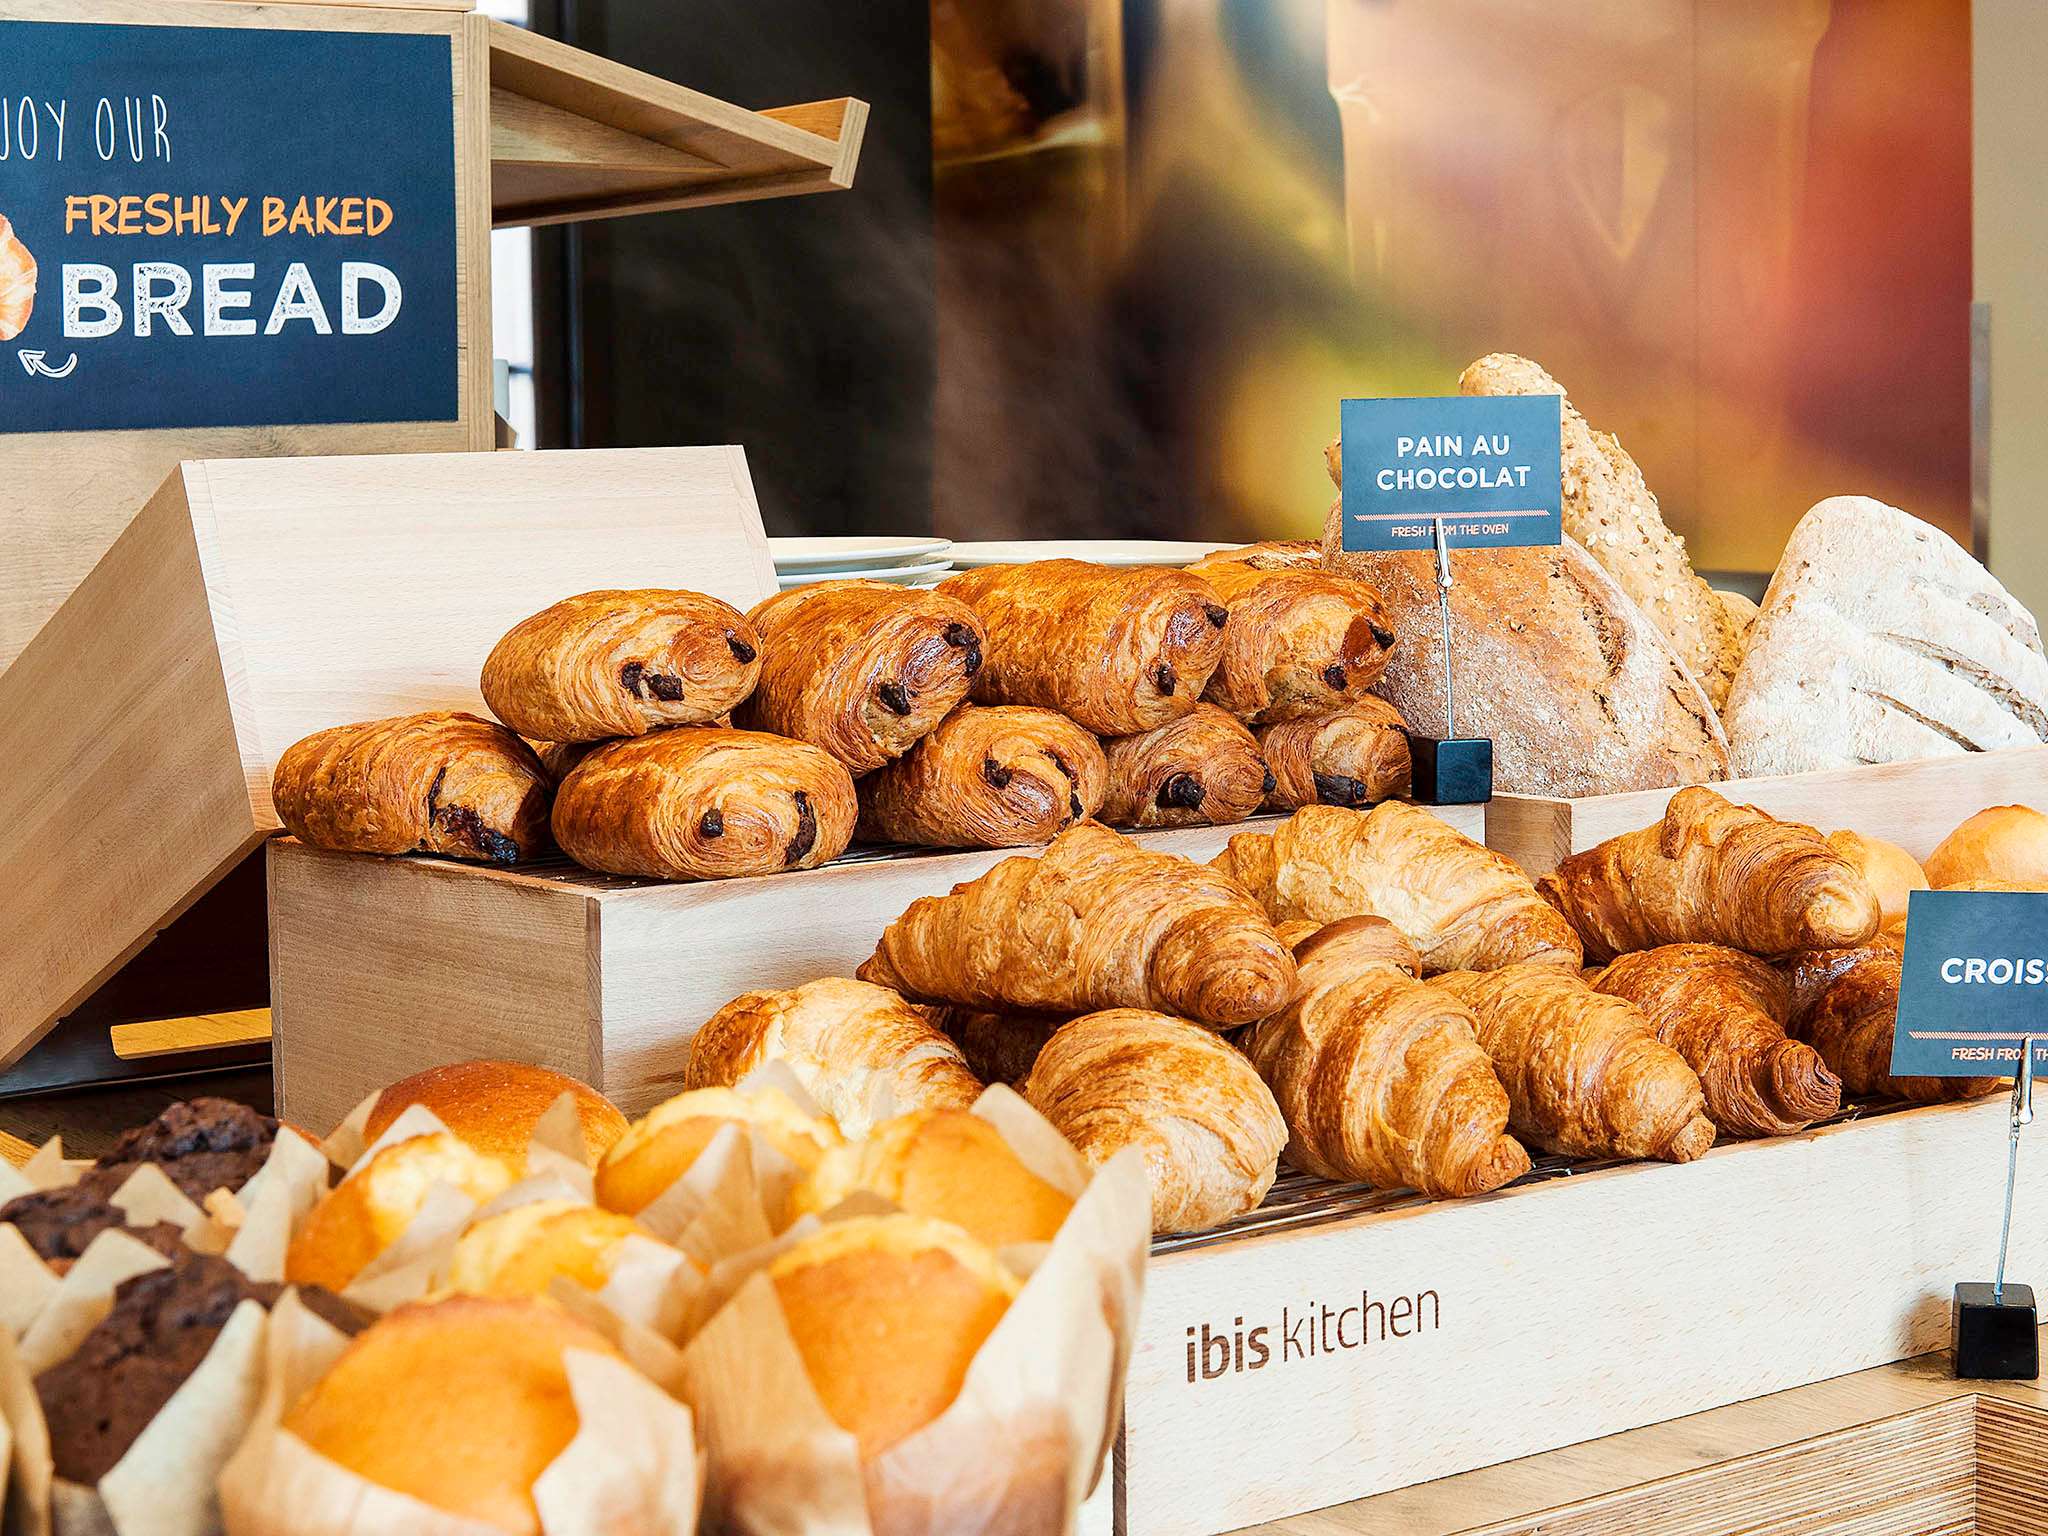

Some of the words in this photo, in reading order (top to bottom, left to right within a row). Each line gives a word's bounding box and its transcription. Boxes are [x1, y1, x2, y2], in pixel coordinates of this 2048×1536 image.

[95, 94, 171, 162] OUR
[64, 193, 249, 237] FRESHLY
[262, 196, 394, 237] BAKED
[62, 262, 403, 338] BREAD
[1396, 435, 1462, 458] PAIN
[1471, 434, 1511, 456] AU
[1376, 465, 1532, 491] CHOCOLAT
[1391, 525, 1426, 537] FRESH
[1428, 525, 1457, 536] FOM
[1459, 524, 1480, 536] THE
[1481, 523, 1509, 535] OVEN
[1941, 957, 2048, 985] CROIS
[1951, 1047, 1995, 1061] FRESH
[1996, 1047, 2025, 1061] FRO
[1186, 1316, 1270, 1384] ibis
[1283, 1289, 1440, 1363] kitchen
